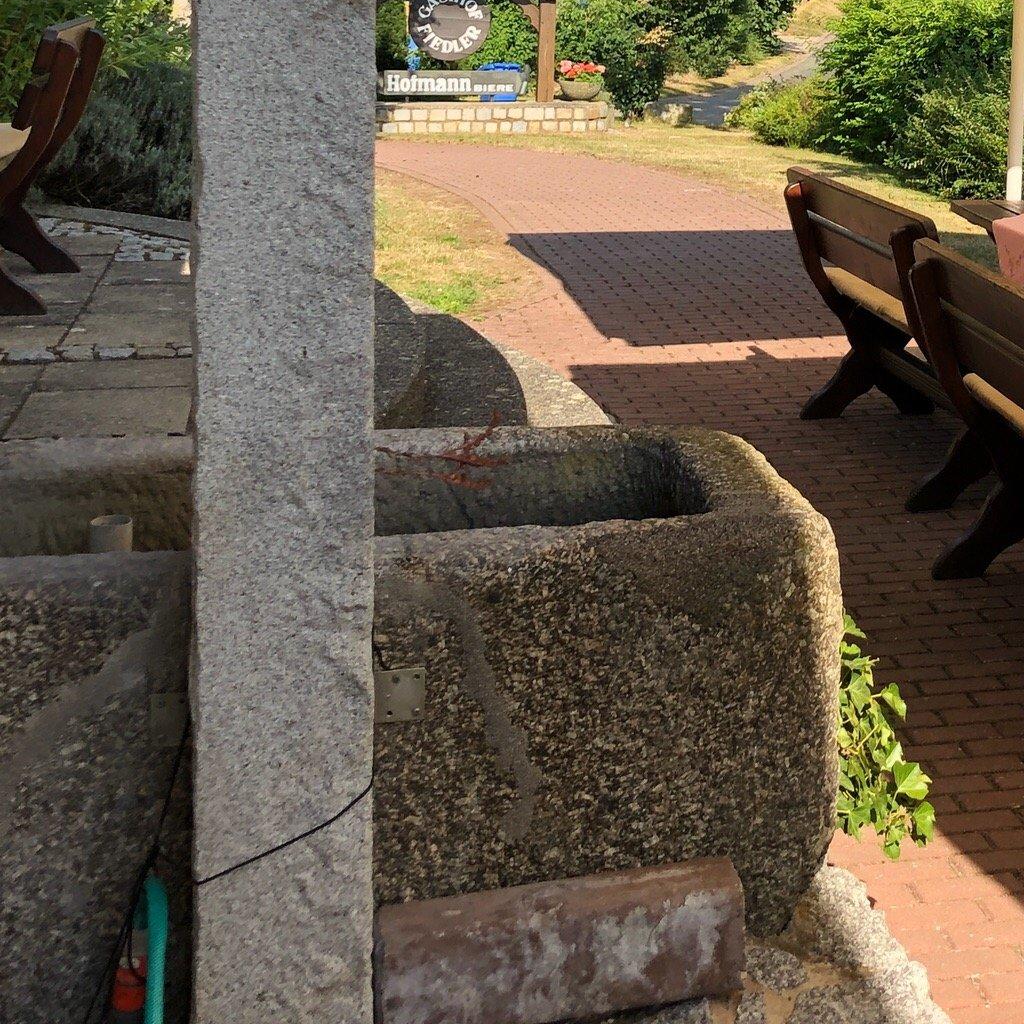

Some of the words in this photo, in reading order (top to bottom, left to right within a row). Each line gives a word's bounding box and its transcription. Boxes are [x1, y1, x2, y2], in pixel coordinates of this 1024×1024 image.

[417, 23, 481, 53] FIEDLER
[387, 74, 472, 92] Hofmann
[474, 83, 514, 92] BIERE
